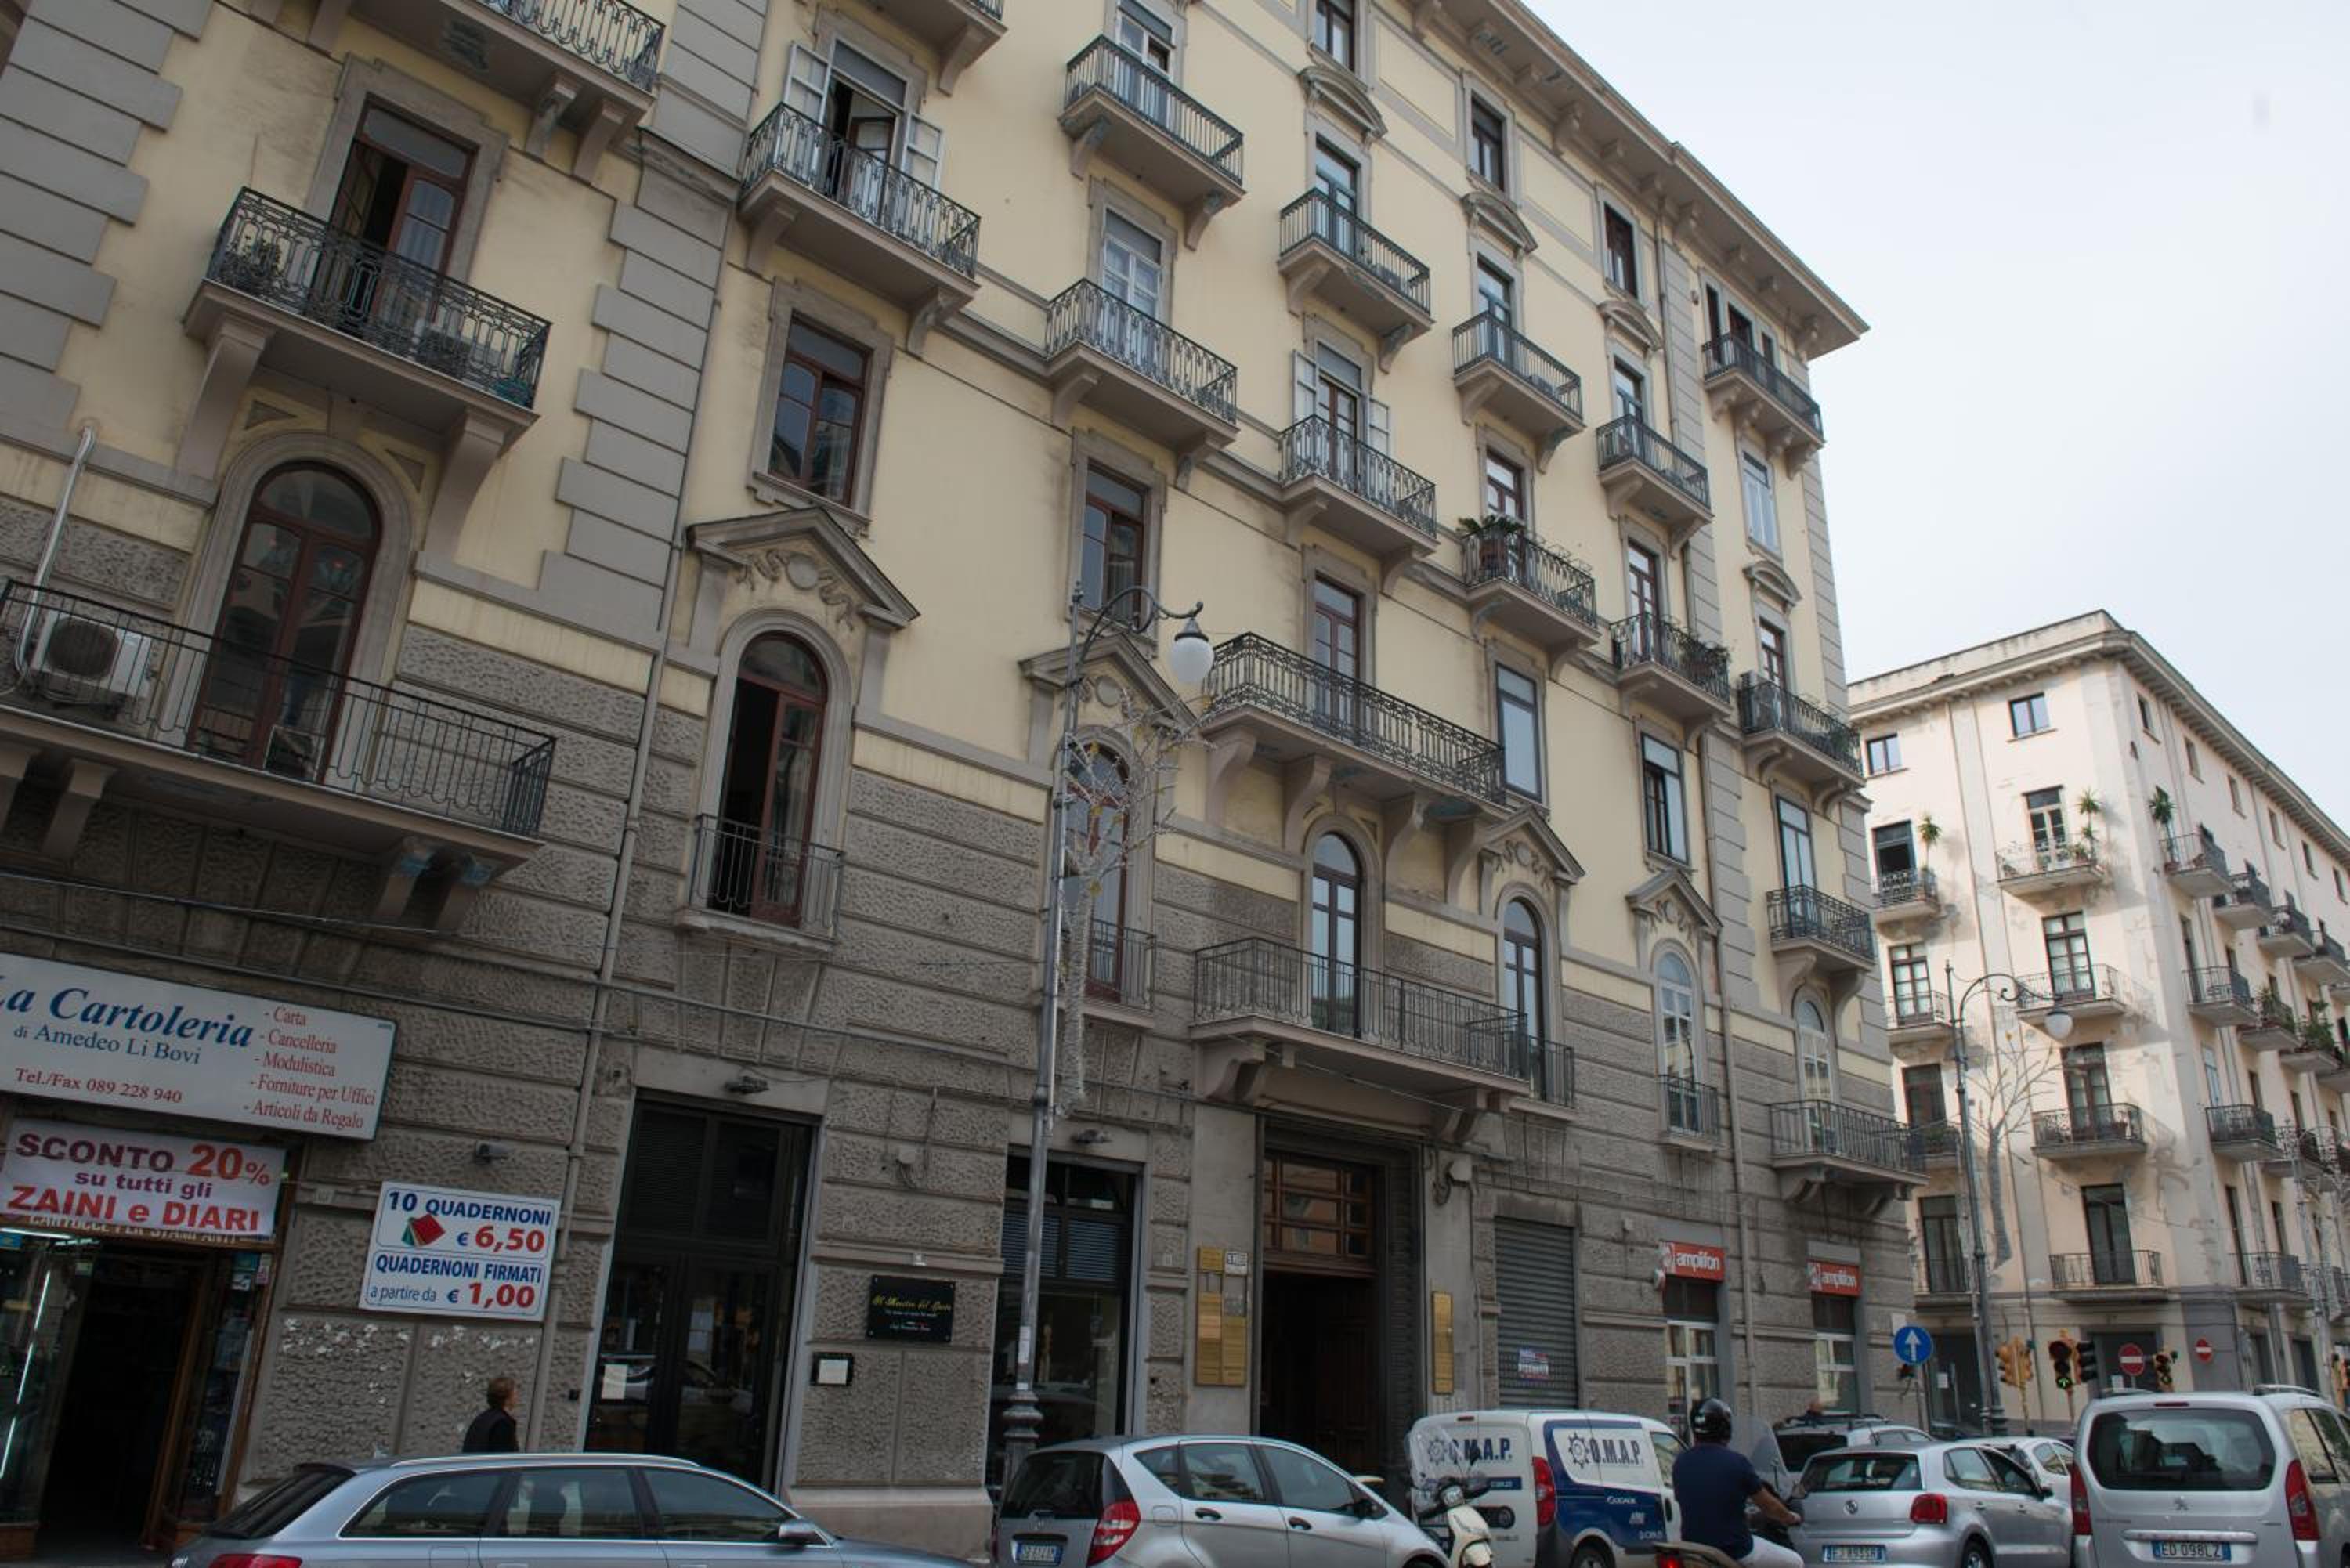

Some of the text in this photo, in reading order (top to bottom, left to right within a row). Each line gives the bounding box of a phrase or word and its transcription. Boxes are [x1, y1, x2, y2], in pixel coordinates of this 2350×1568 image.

[0, 976, 254, 1046] a Cartoleria
[274, 1006, 306, 1026] Carta
[13, 1024, 201, 1064] di Amedeo Li Bovi
[268, 1028, 337, 1053] Cancelleria
[262, 1051, 335, 1077] Modulistica
[16, 1068, 183, 1104] Tel./Fax 089 228 940
[258, 1074, 376, 1106] Forniture per Uffici
[251, 1100, 363, 1130] Articoli da Regalo
[15, 1133, 270, 1187] SCONTO 20%
[74, 1172, 214, 1202] su tutti gli
[7, 1185, 260, 1232] ZAINI e DIARI
[389, 1191, 551, 1226] 10 QUADERNONI
[457, 1225, 546, 1252] € 6,50
[375, 1254, 542, 1283] QUADERNONI FIRMATI
[370, 1282, 535, 1309] a partire da € 1,00
